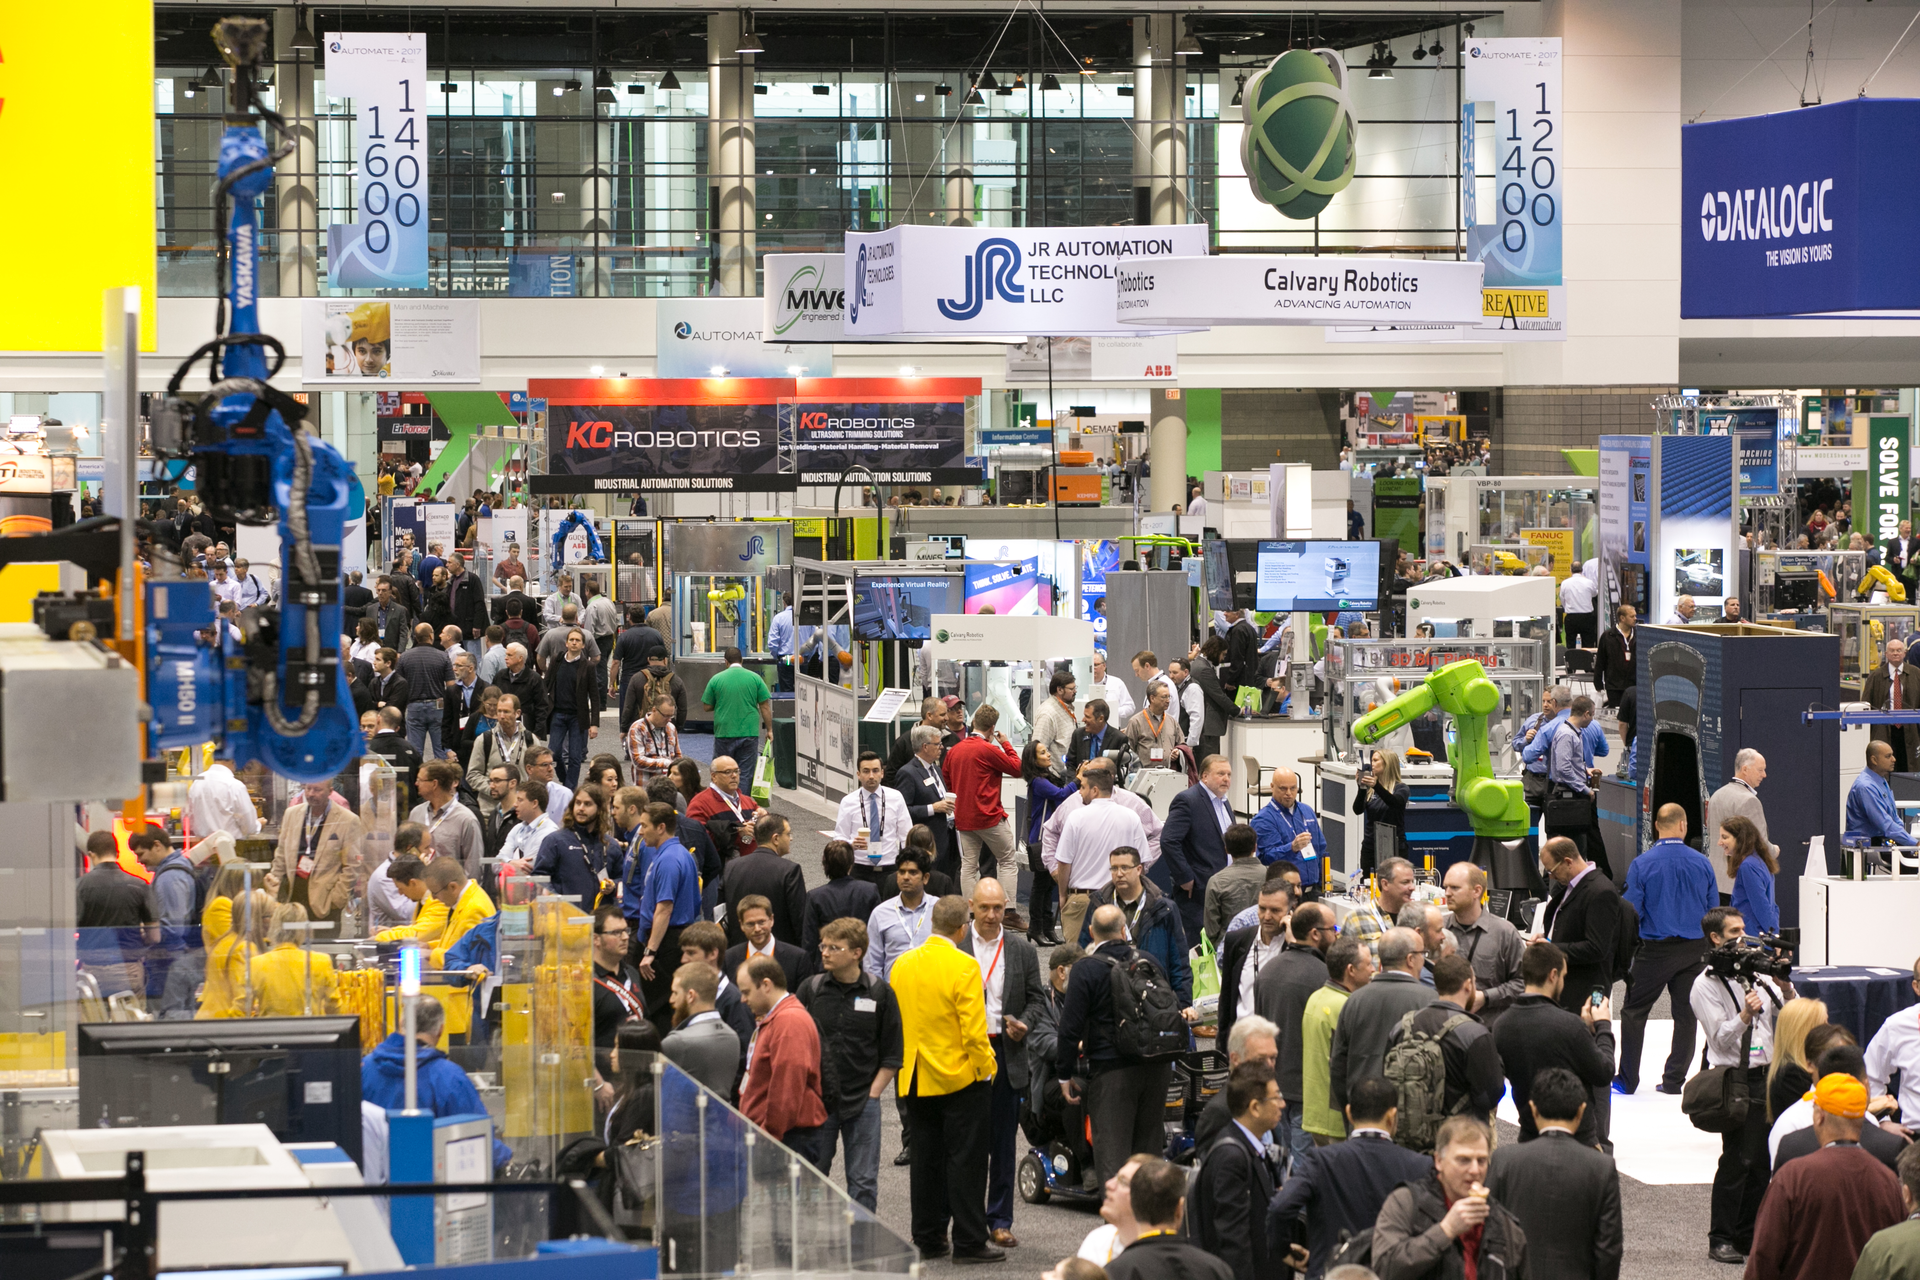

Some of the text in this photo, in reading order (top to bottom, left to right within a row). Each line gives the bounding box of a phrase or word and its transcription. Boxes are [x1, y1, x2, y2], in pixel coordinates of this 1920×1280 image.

[341, 47, 395, 55] AUTOMATE
[394, 79, 421, 228] 1400
[1531, 82, 1556, 227] 1200
[364, 106, 391, 254] 1600
[1502, 108, 1527, 253] 1400
[1717, 178, 1833, 241] DATALOGIC
[1028, 239, 1173, 258] JR AUTOMATION
[1766, 243, 1833, 267] THE VISION IS YOURS
[236, 224, 253, 309] YASKAWA
[1029, 265, 1118, 280] TECHNOL
[867, 265, 895, 285] TECHNOLOGIES
[1120, 271, 1155, 294] Robotics
[1264, 268, 1418, 296] Calvary Robotics
[1031, 288, 1064, 303] LLC
[1274, 299, 1412, 310] ADVANCING AUTOMATION
[802, 312, 840, 323] engineered
[692, 331, 763, 341] AUTOMAT
[1144, 365, 1172, 376] ABB
[1167, 389, 1180, 398] EXIT
[392, 423, 431, 434] EnForcer
[811, 430, 904, 439] ULTRASONIC TRIMMING SOLUTIONS
[992, 433, 1022, 441] Information
[910, 442, 939, 450] Removal
[594, 477, 733, 490] INDUSTRIAL AUTOMATION SOLUTIONS
[891, 471, 932, 483] SOLUTIONS
[1879, 436, 1899, 541] SOLVE FOR
[871, 581, 905, 589] Experience
[927, 581, 950, 589] Reality!
[1391, 653, 1410, 666] 3D
[1415, 653, 1439, 666] Bin
[176, 661, 196, 712] MH50
